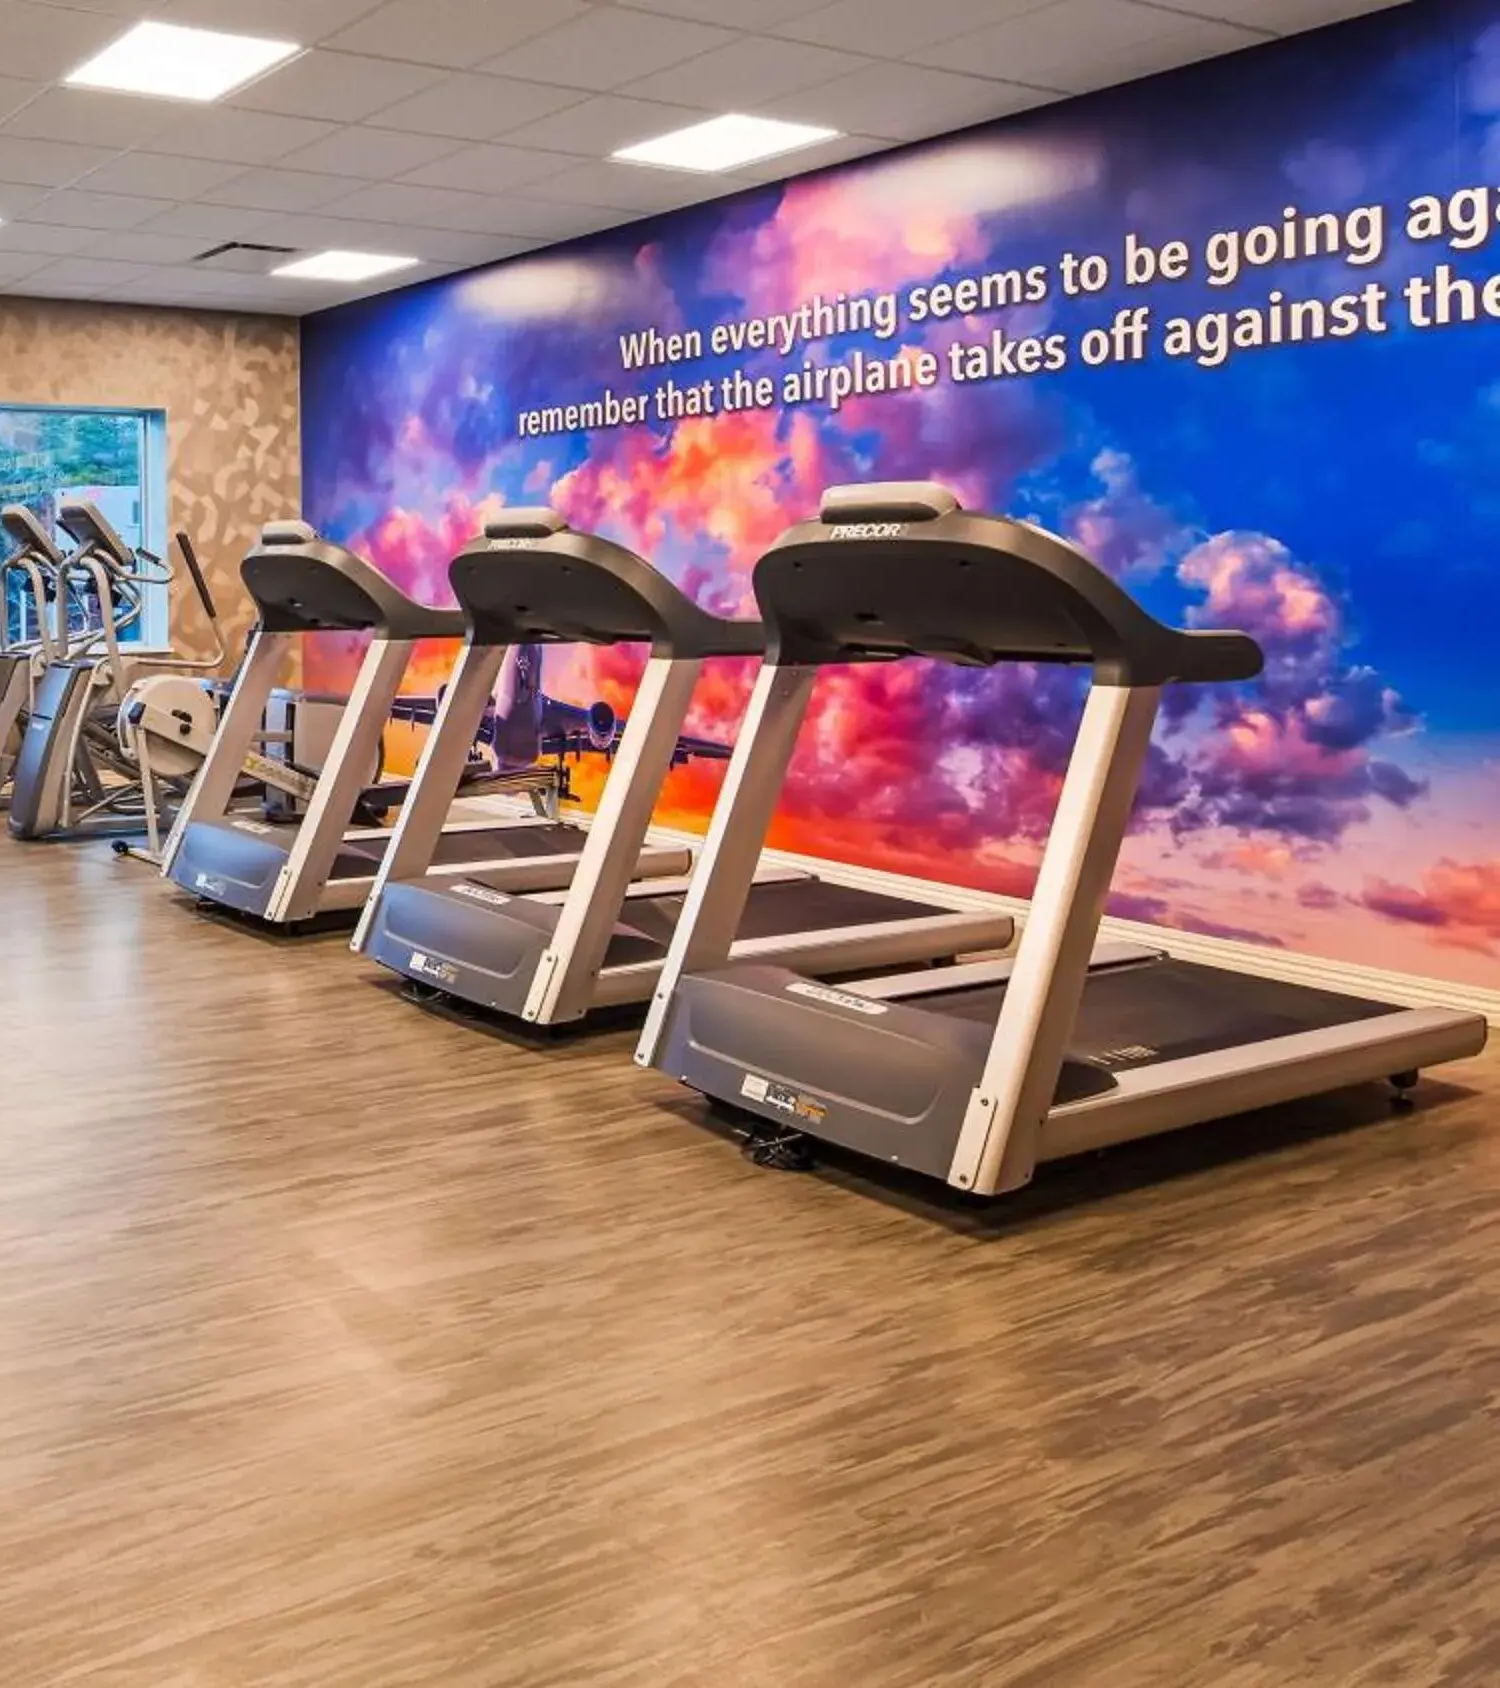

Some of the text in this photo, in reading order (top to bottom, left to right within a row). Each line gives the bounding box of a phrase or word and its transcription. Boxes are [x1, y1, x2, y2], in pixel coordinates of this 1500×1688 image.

[619, 186, 1500, 369] When everything seems to be going ag
[518, 393, 648, 436] remember
[656, 380, 714, 419] that
[721, 370, 773, 409] the
[782, 352, 937, 408] airplane
[949, 329, 1066, 381] takes
[1081, 307, 1149, 365] off
[1164, 282, 1387, 366] against
[830, 523, 902, 540] PRECOR
